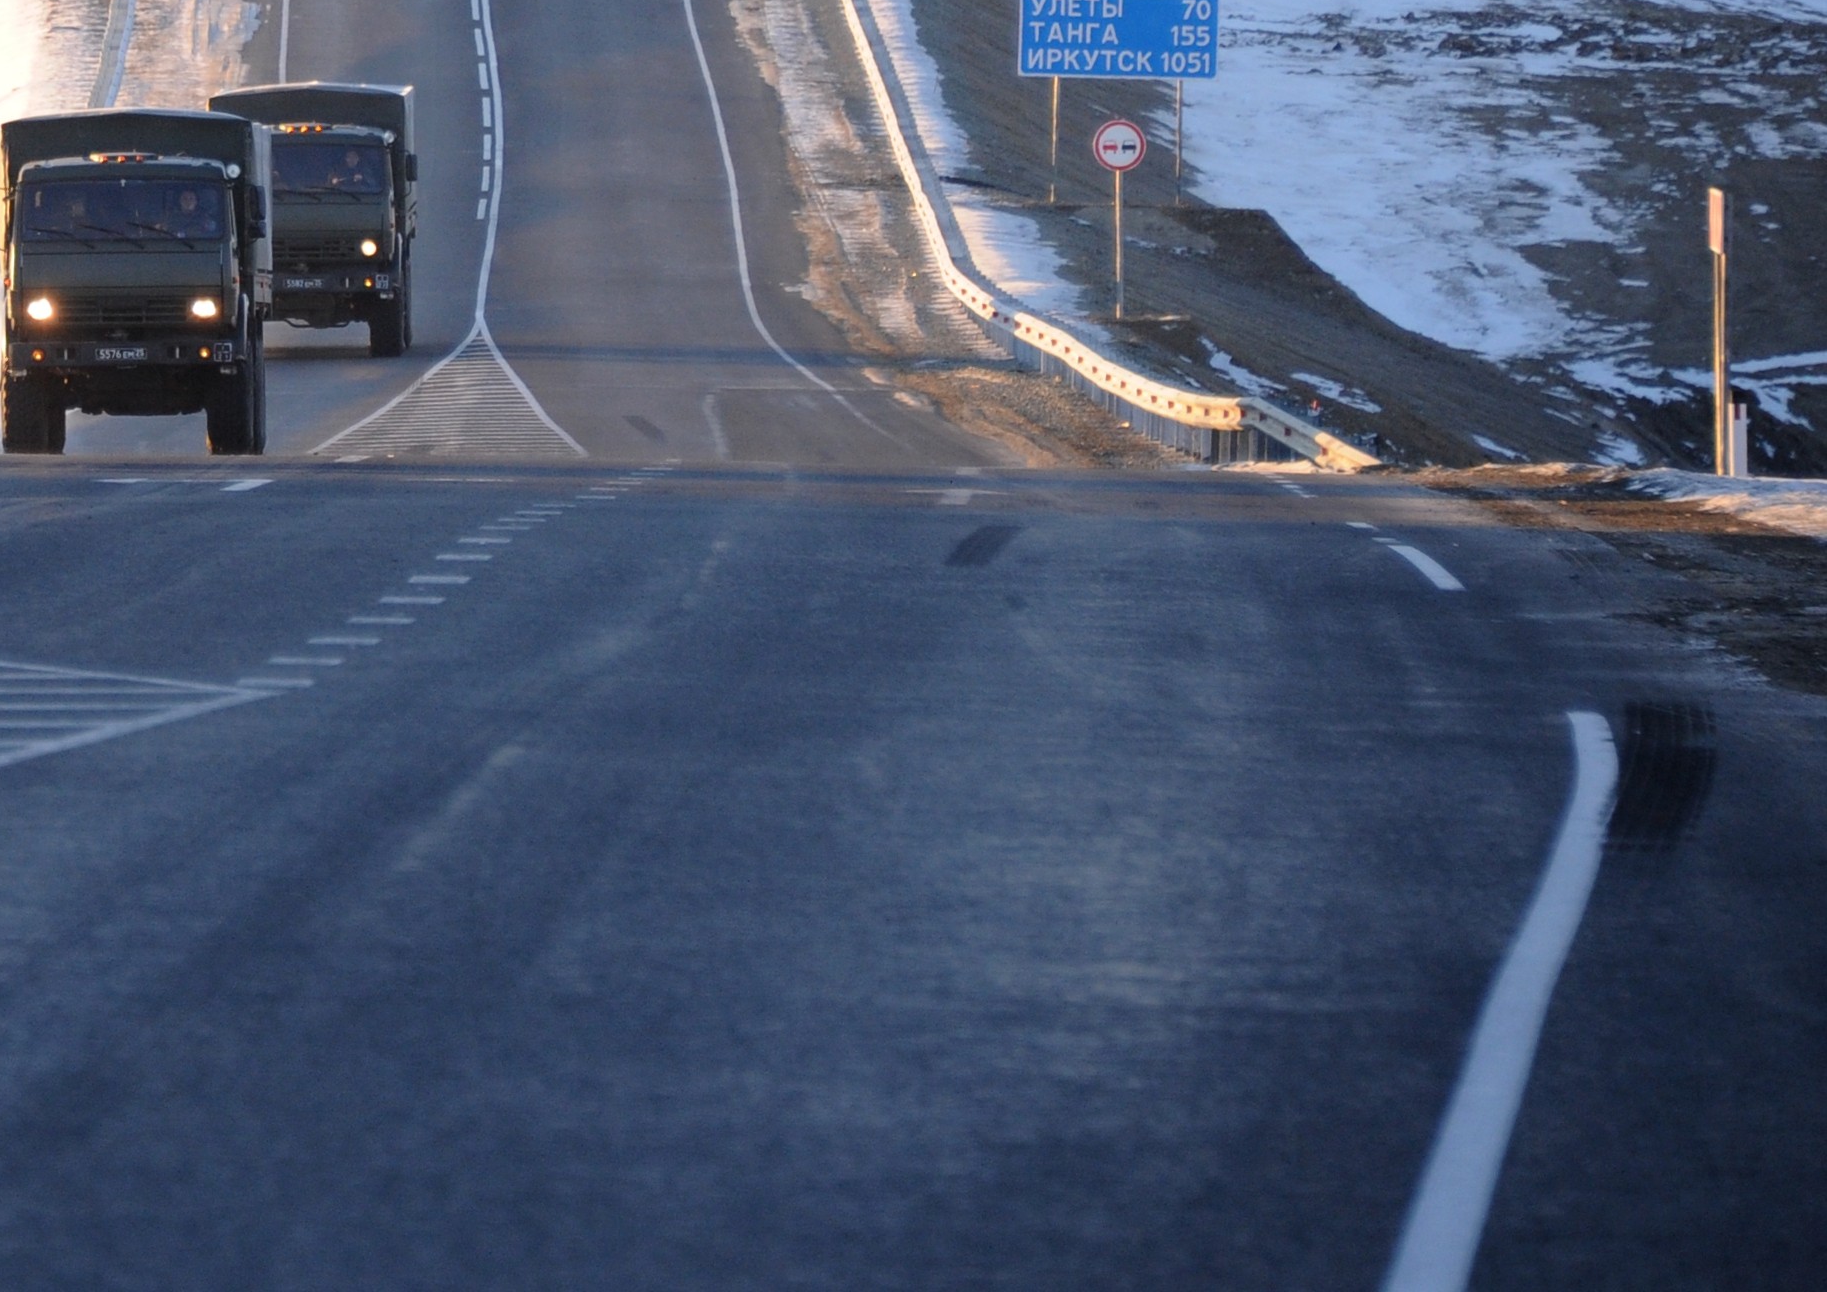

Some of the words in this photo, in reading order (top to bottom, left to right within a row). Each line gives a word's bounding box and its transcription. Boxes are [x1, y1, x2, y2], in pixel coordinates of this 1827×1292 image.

[1029, 21, 1119, 45] ТАНГА
[1170, 25, 1211, 47] 155
[1026, 48, 1153, 73] ИРКУТСК
[1160, 51, 1211, 74] 1051
[99, 348, 122, 359] 5576
